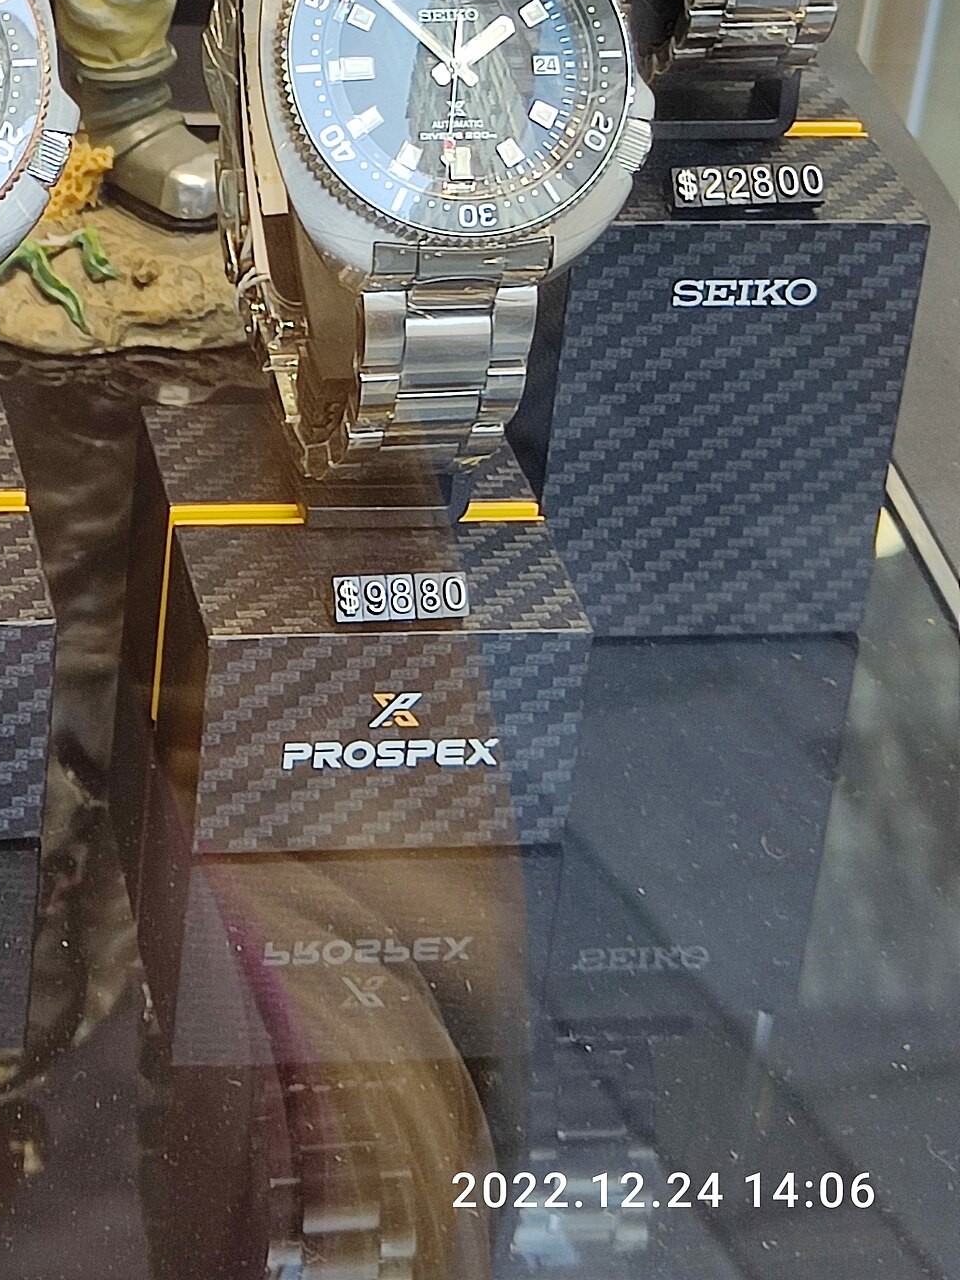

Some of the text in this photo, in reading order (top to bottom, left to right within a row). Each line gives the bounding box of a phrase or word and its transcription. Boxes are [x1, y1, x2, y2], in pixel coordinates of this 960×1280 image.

[418, 8, 479, 22] SEIKO
[536, 58, 556, 72] 24
[320, 123, 356, 164] 40
[583, 116, 614, 153] 20
[676, 164, 824, 202] $22800
[457, 202, 499, 228] 30
[672, 278, 818, 307] SEIKO
[336, 576, 467, 617] $9880
[282, 737, 500, 770] PROSPEX
